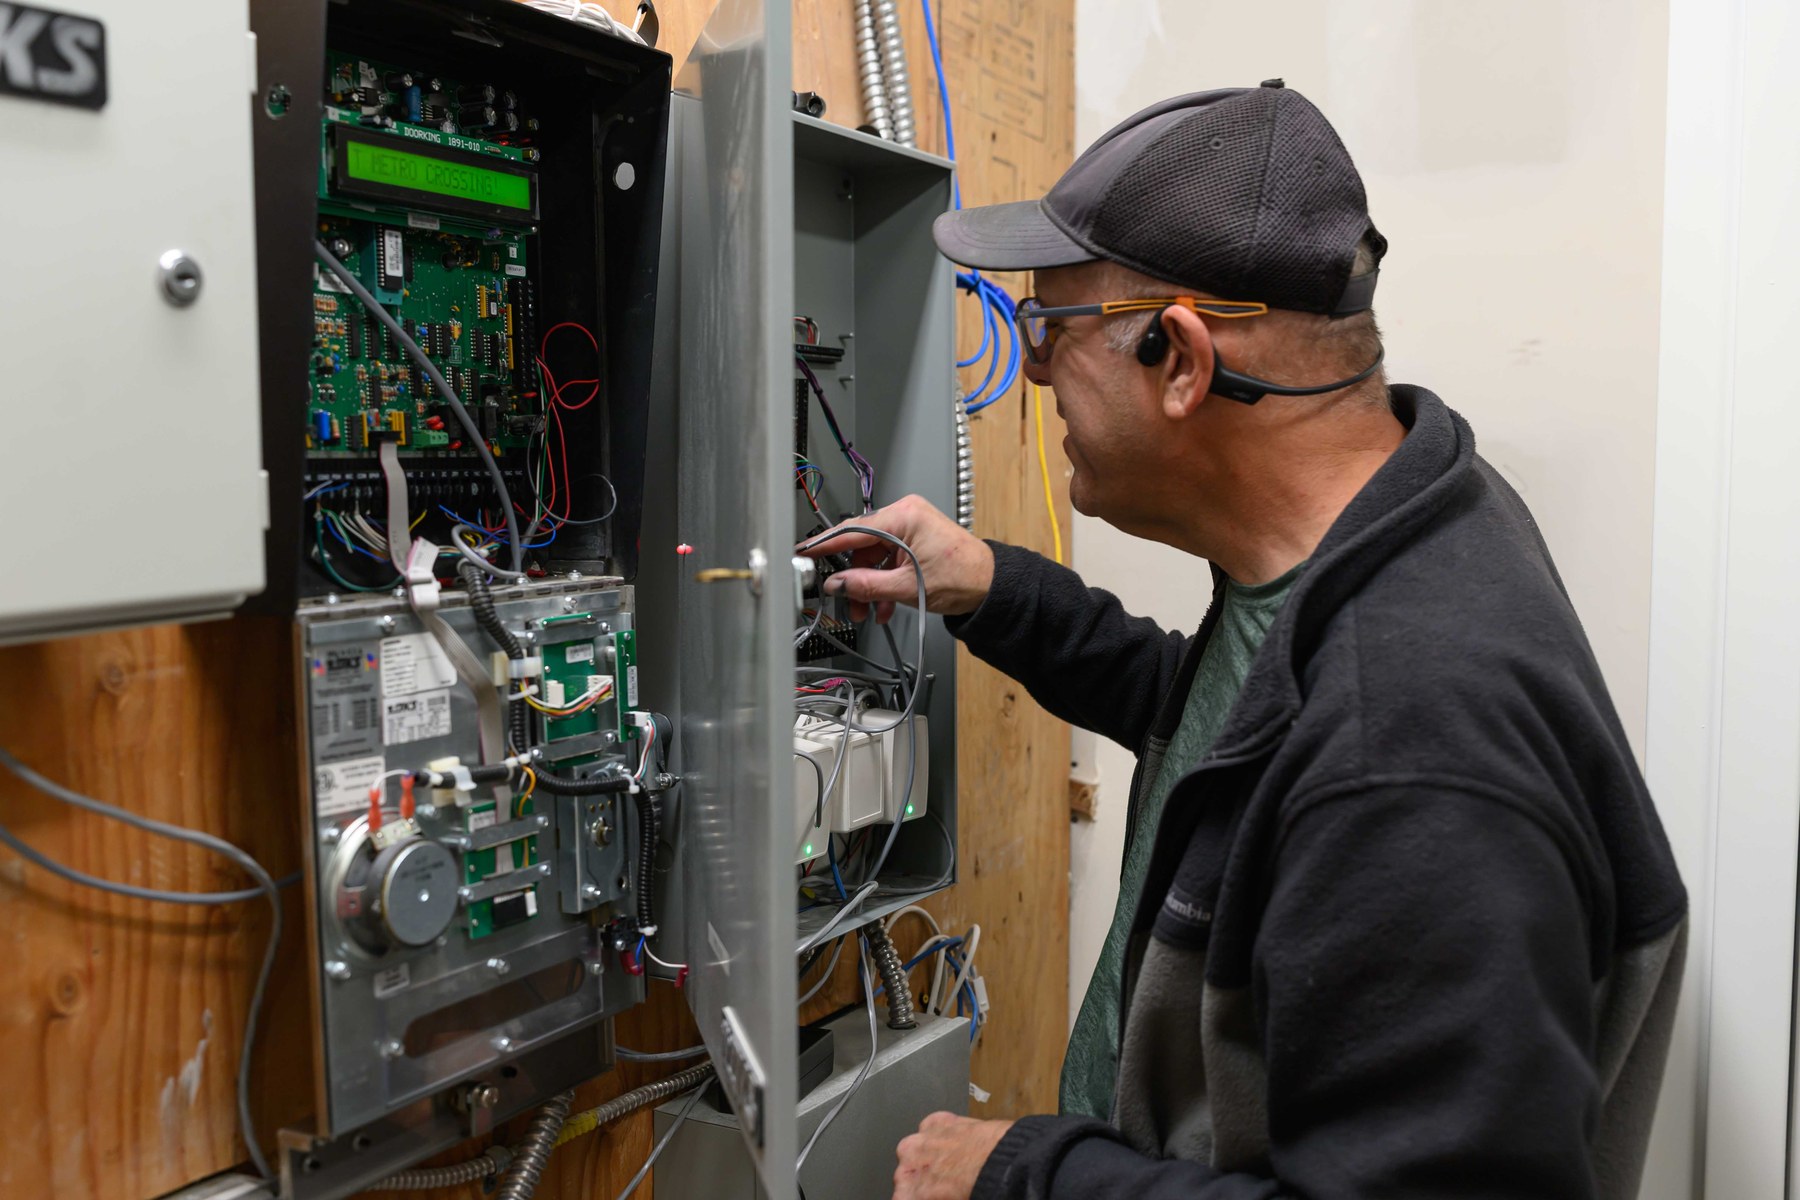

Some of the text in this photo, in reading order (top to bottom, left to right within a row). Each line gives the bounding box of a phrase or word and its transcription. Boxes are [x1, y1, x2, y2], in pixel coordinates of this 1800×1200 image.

[404, 126, 481, 152] DOORKING 1891-010
[372, 152, 418, 181] METRO
